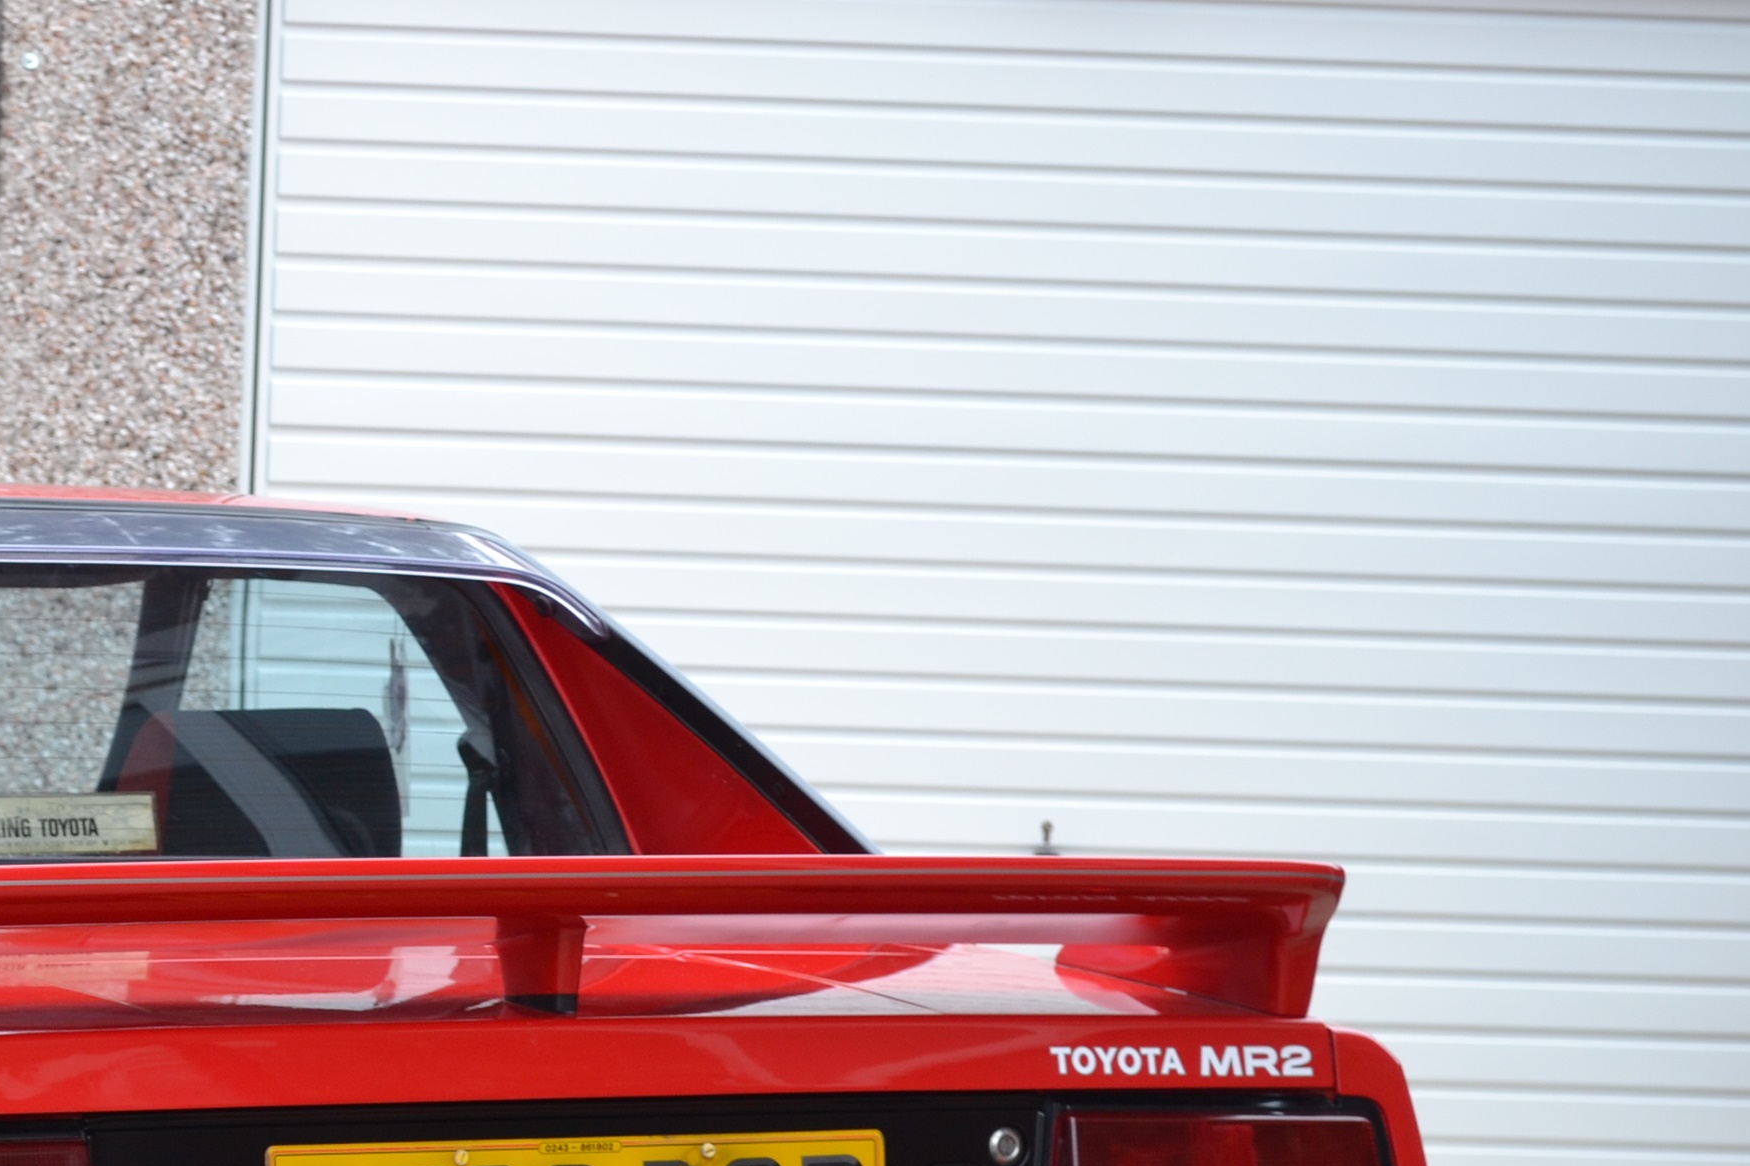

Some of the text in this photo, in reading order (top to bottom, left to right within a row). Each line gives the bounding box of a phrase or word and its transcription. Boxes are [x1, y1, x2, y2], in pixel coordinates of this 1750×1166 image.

[37, 817, 99, 838] TOYOTA
[1049, 1044, 1314, 1077] TOYOTA MR2
